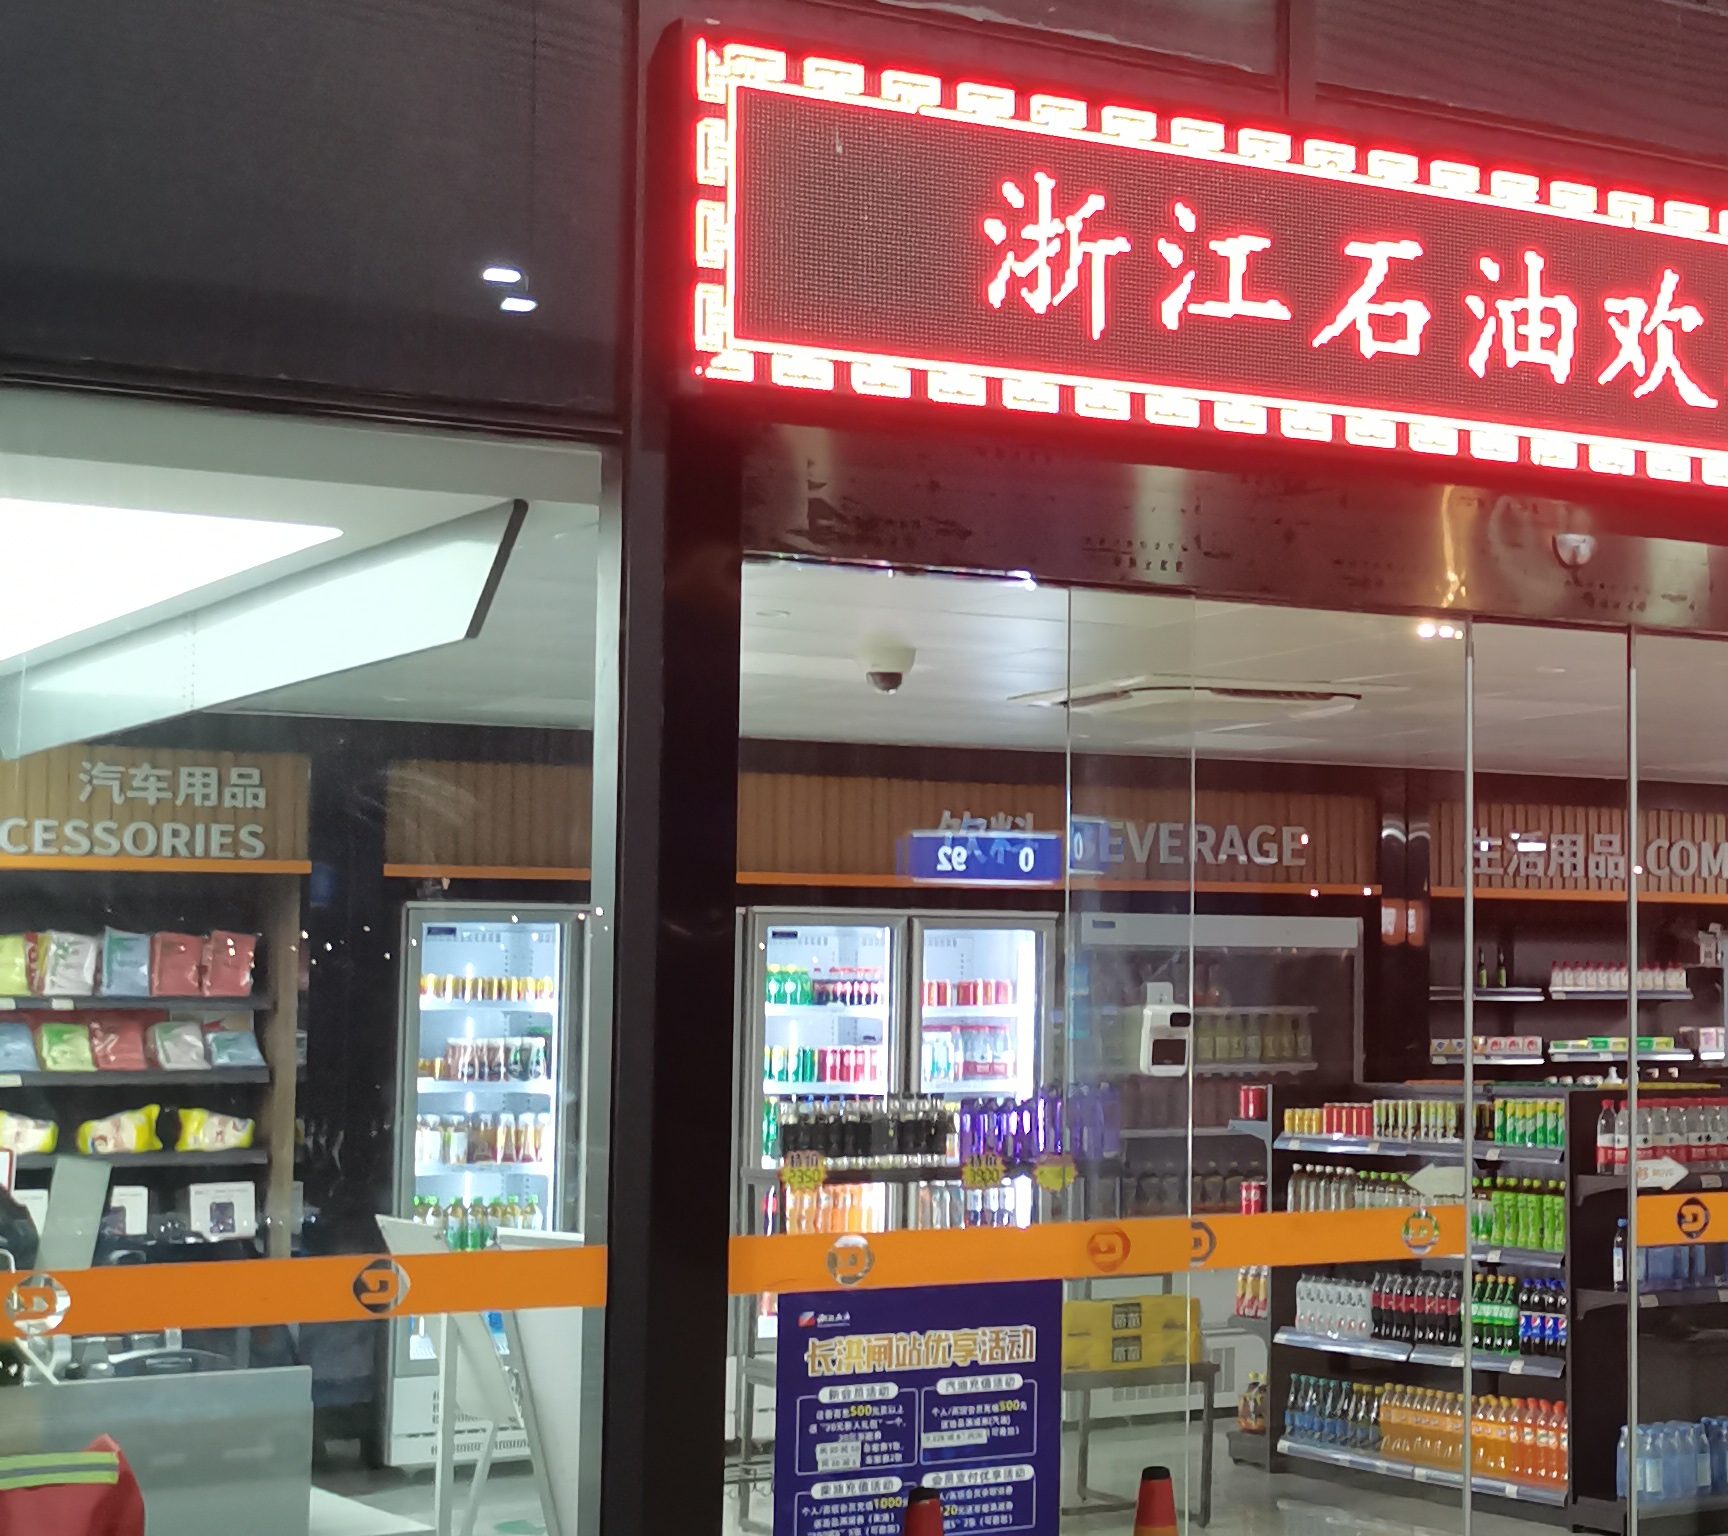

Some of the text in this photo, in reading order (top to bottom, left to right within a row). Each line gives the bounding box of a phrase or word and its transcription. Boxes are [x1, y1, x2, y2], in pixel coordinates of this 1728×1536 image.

[79, 761, 267, 809] 汽车用品
[0, 818, 266, 858] CESSORIES
[1471, 828, 1625, 879] 生活用品
